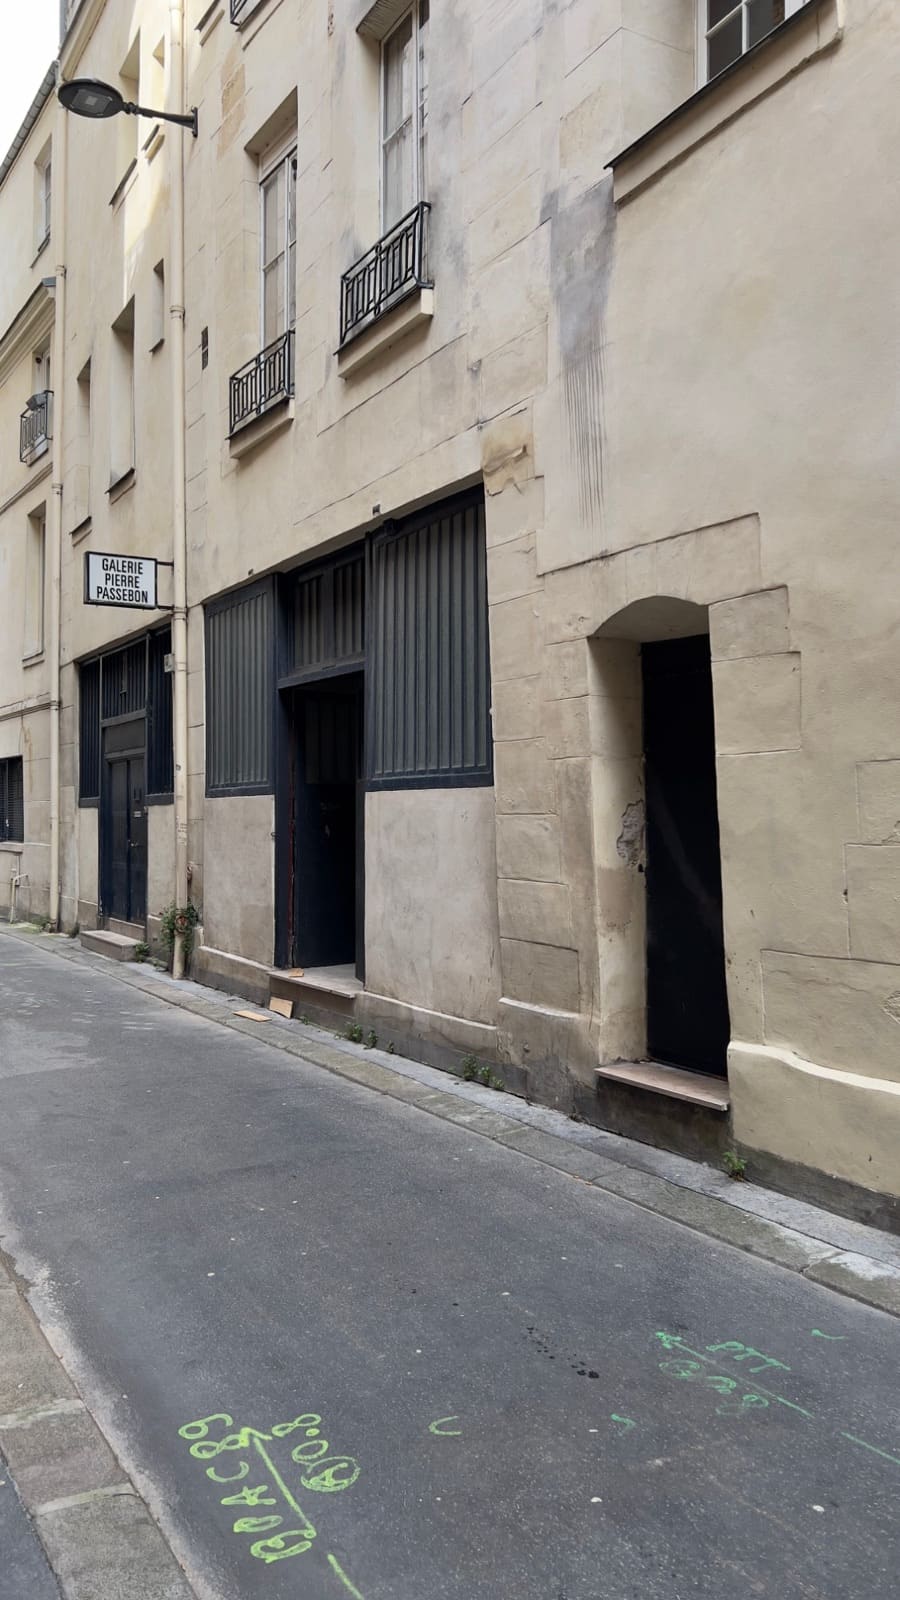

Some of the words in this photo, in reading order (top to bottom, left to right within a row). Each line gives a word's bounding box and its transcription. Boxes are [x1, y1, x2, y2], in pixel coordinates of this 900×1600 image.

[102, 558, 144, 575] GALERIE
[105, 572, 140, 589] PIERRE
[96, 586, 149, 604] PASSEBON
